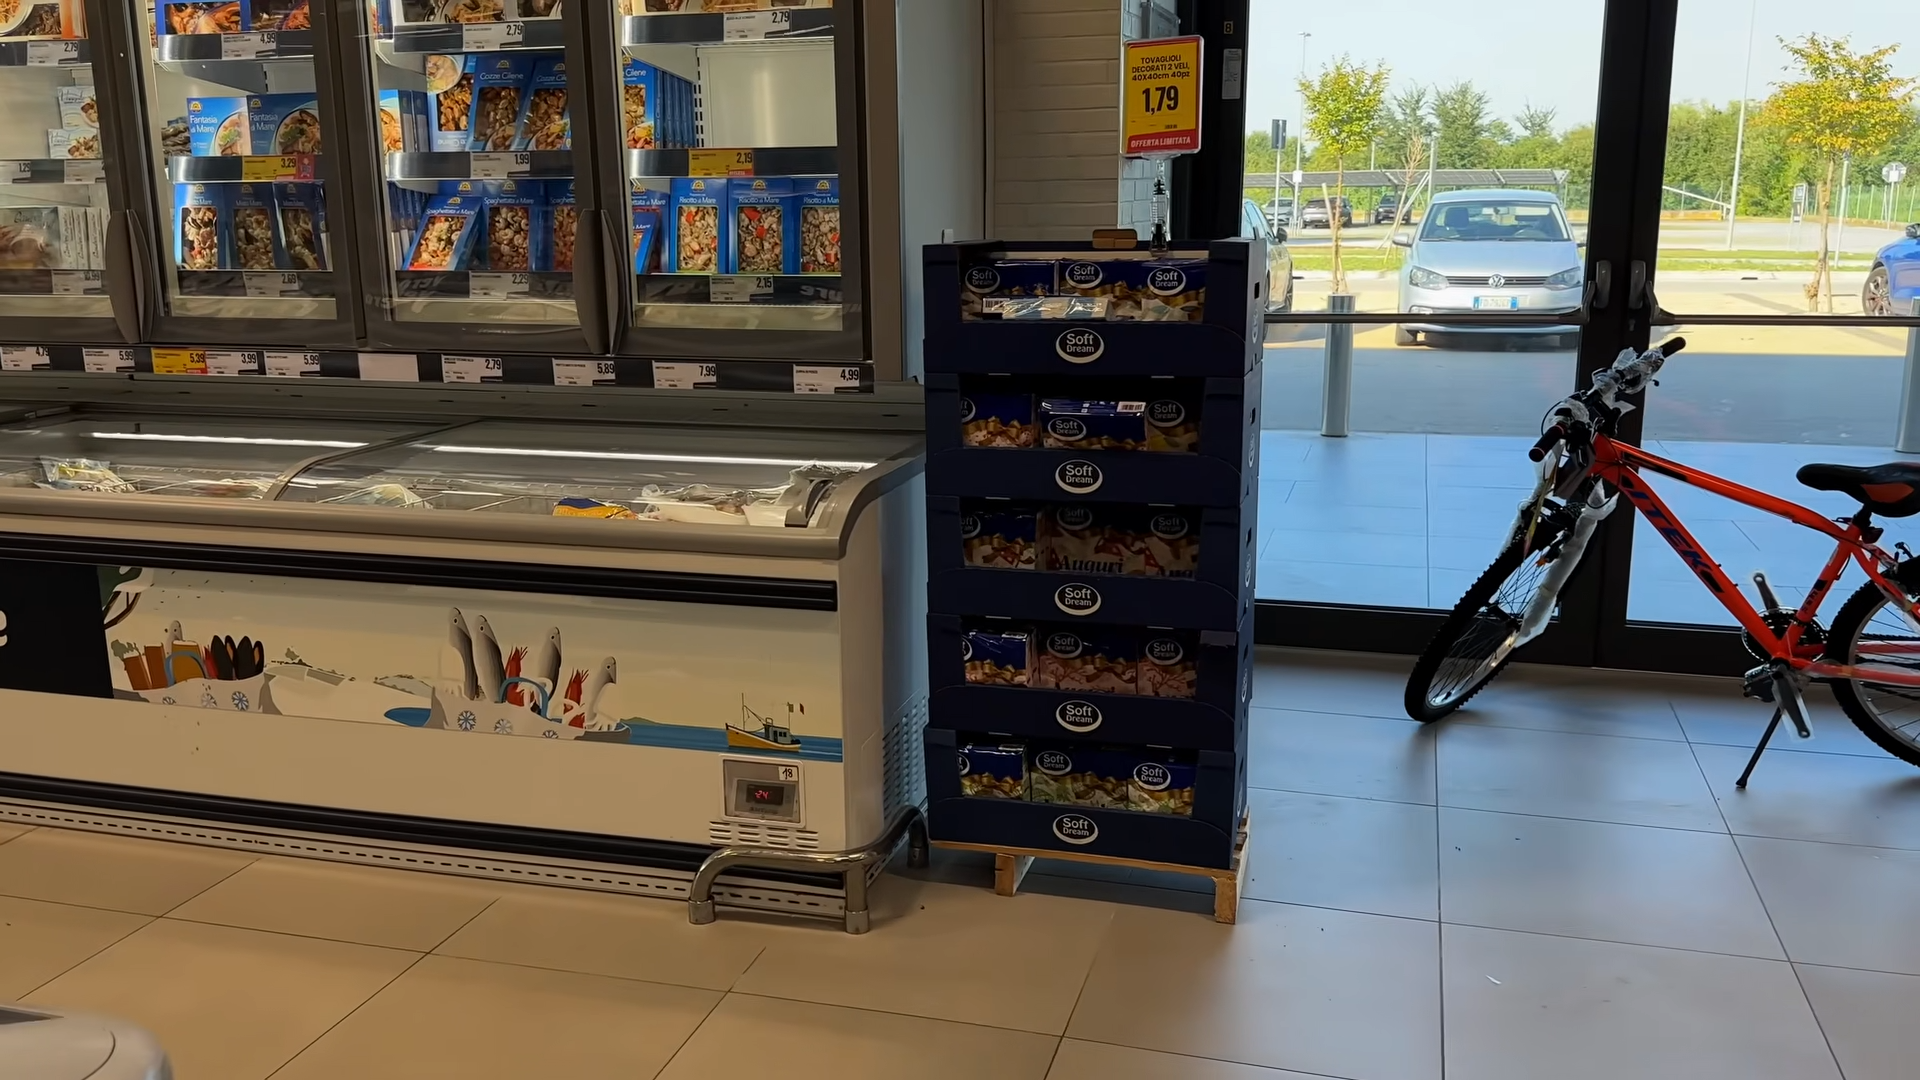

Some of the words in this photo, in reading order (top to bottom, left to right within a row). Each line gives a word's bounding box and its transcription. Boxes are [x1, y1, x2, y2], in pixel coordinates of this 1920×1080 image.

[772, 11, 790, 24] 2,79
[506, 24, 522, 36] 2,79
[1225, 23, 1231, 33] 8
[260, 33, 276, 45] 4,99
[64, 42, 78, 52] 2,79
[1141, 55, 1181, 64] TOVAGLIOLI
[1131, 64, 1167, 74] DECORATI
[1174, 62, 1190, 70] VELI,
[1171, 71, 1190, 80] 40pz
[1142, 85, 1179, 116] 1,79
[190, 115, 218, 124] Fantasia
[250, 112, 278, 121] Fantasia
[257, 123, 275, 131] Mare
[1131, 138, 1159, 148] OFFERTA
[1160, 136, 1191, 146] LIMITATA
[281, 158, 296, 168] 3,29
[515, 153, 530, 165] 1,99
[736, 152, 752, 164] 2,19
[19, 162, 30, 173] 1,29
[972, 270, 993, 279] Soft
[1073, 265, 1095, 275] Soft
[1155, 270, 1178, 280] Soft
[512, 274, 529, 286] 2,29
[756, 277, 772, 289] 2,15
[1067, 333, 1093, 345] Soft
[1067, 344, 1094, 353] Dream
[119, 350, 133, 361] 5,99
[190, 353, 205, 364] 5,39
[241, 353, 257, 364] 3,99
[303, 354, 320, 366] 5,99
[485, 359, 501, 371] 2,79
[597, 362, 615, 375] 5,89
[699, 365, 716, 377] 7,99
[840, 369, 859, 381] 4,99
[1154, 403, 1176, 413] Soft
[1056, 420, 1078, 429] Soft
[1066, 464, 1092, 476] Soft
[1066, 475, 1093, 483] Dream
[1063, 507, 1084, 518] Soft
[1158, 516, 1180, 527] Soft
[1058, 556, 1124, 575] Auguri
[1065, 588, 1091, 599] Soft
[1065, 598, 1092, 606] Dream
[1054, 636, 1075, 646] Soft
[1153, 642, 1175, 652] Soft
[1066, 704, 1092, 716] Soft
[1066, 715, 1092, 724] Dream
[1043, 754, 1064, 764] Soft
[782, 767, 793, 780] 18
[1140, 767, 1163, 777] Soft
[1063, 818, 1089, 830] Soft
[1063, 828, 1090, 837] Dream
